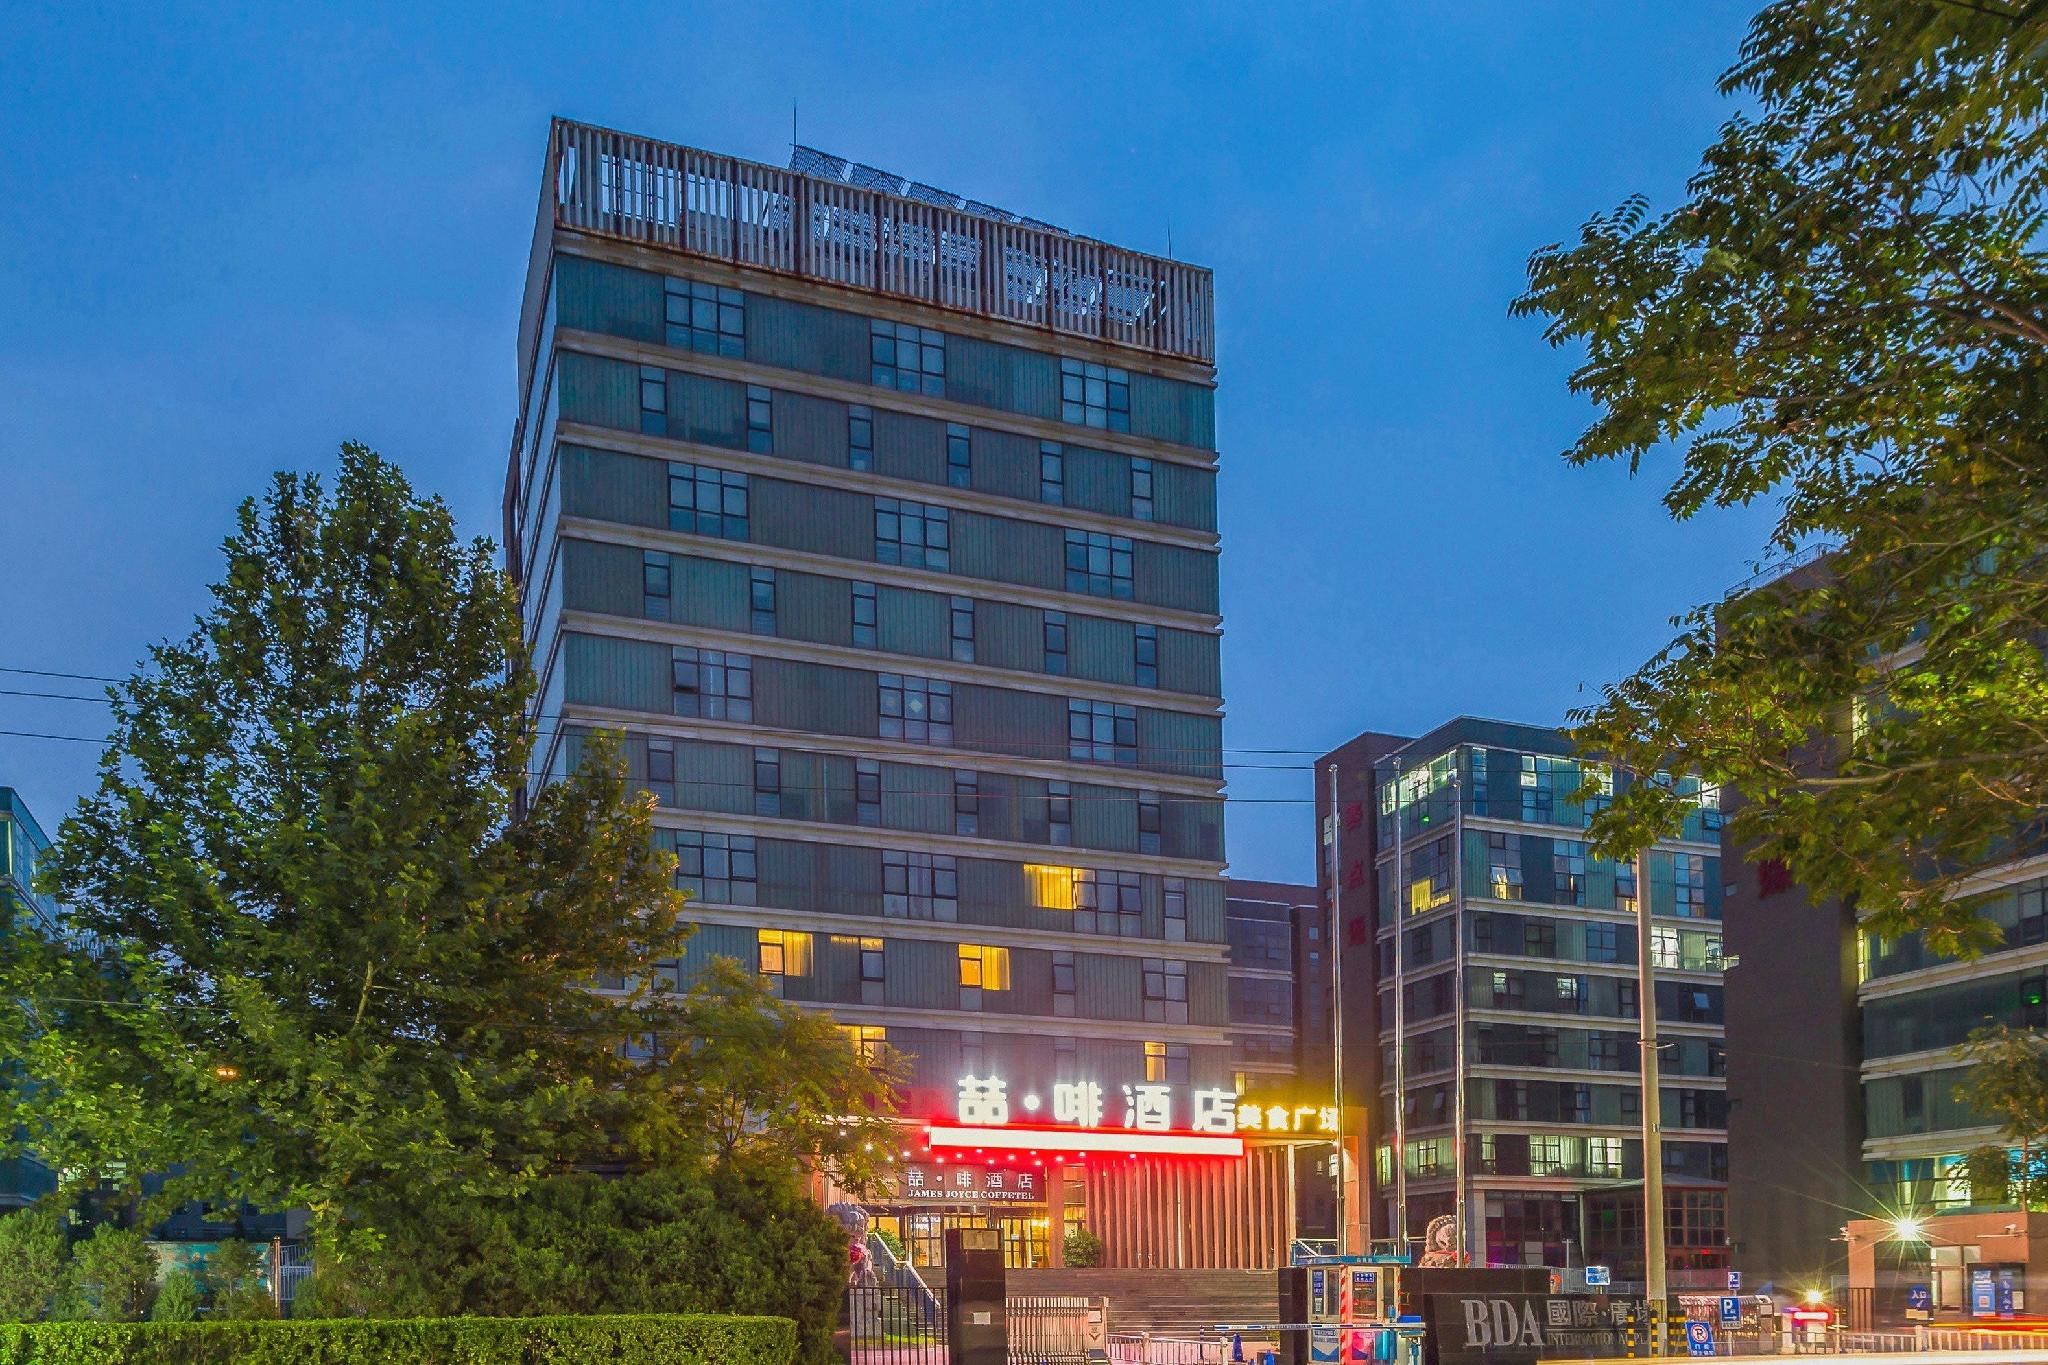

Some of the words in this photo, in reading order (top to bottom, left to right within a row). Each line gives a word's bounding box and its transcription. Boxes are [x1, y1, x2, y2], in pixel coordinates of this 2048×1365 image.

[957, 1074, 1237, 1133] 喆·啡酒店
[1237, 1104, 1338, 1132] 美食广场
[907, 1170, 1033, 1189] 喆·啡酒店
[908, 1189, 943, 1198] JAMES
[945, 1190, 979, 1199] JOYCE
[980, 1190, 1034, 1200] COFFETEL
[1460, 1299, 1545, 1347] BDA
[1547, 1332, 1628, 1345] INTERNATIOA
